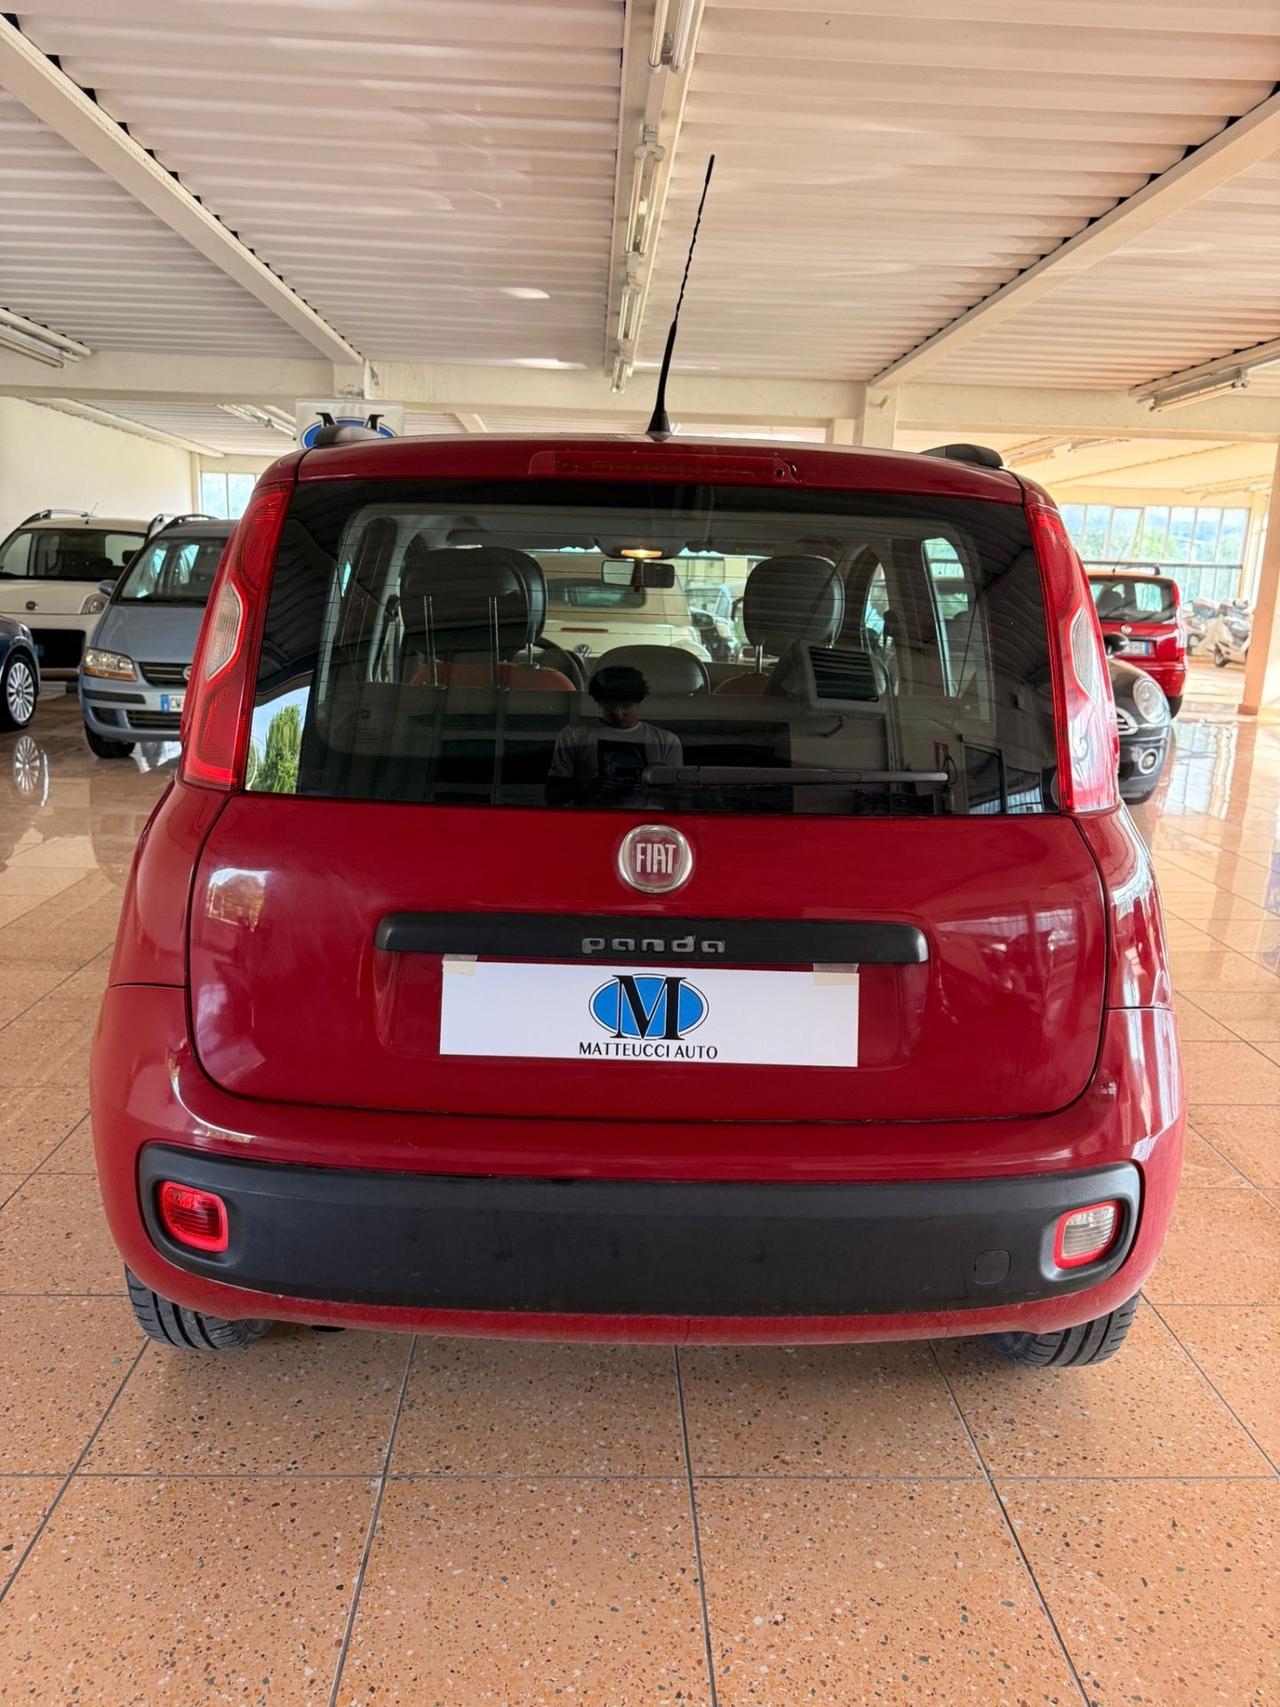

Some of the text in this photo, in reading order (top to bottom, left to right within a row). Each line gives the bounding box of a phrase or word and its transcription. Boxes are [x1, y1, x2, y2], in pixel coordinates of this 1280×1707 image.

[636, 843, 677, 874] FIAT
[581, 935, 726, 954] panda
[610, 974, 687, 1040] M
[579, 1041, 719, 1060] MATTEUCCI AUTO
